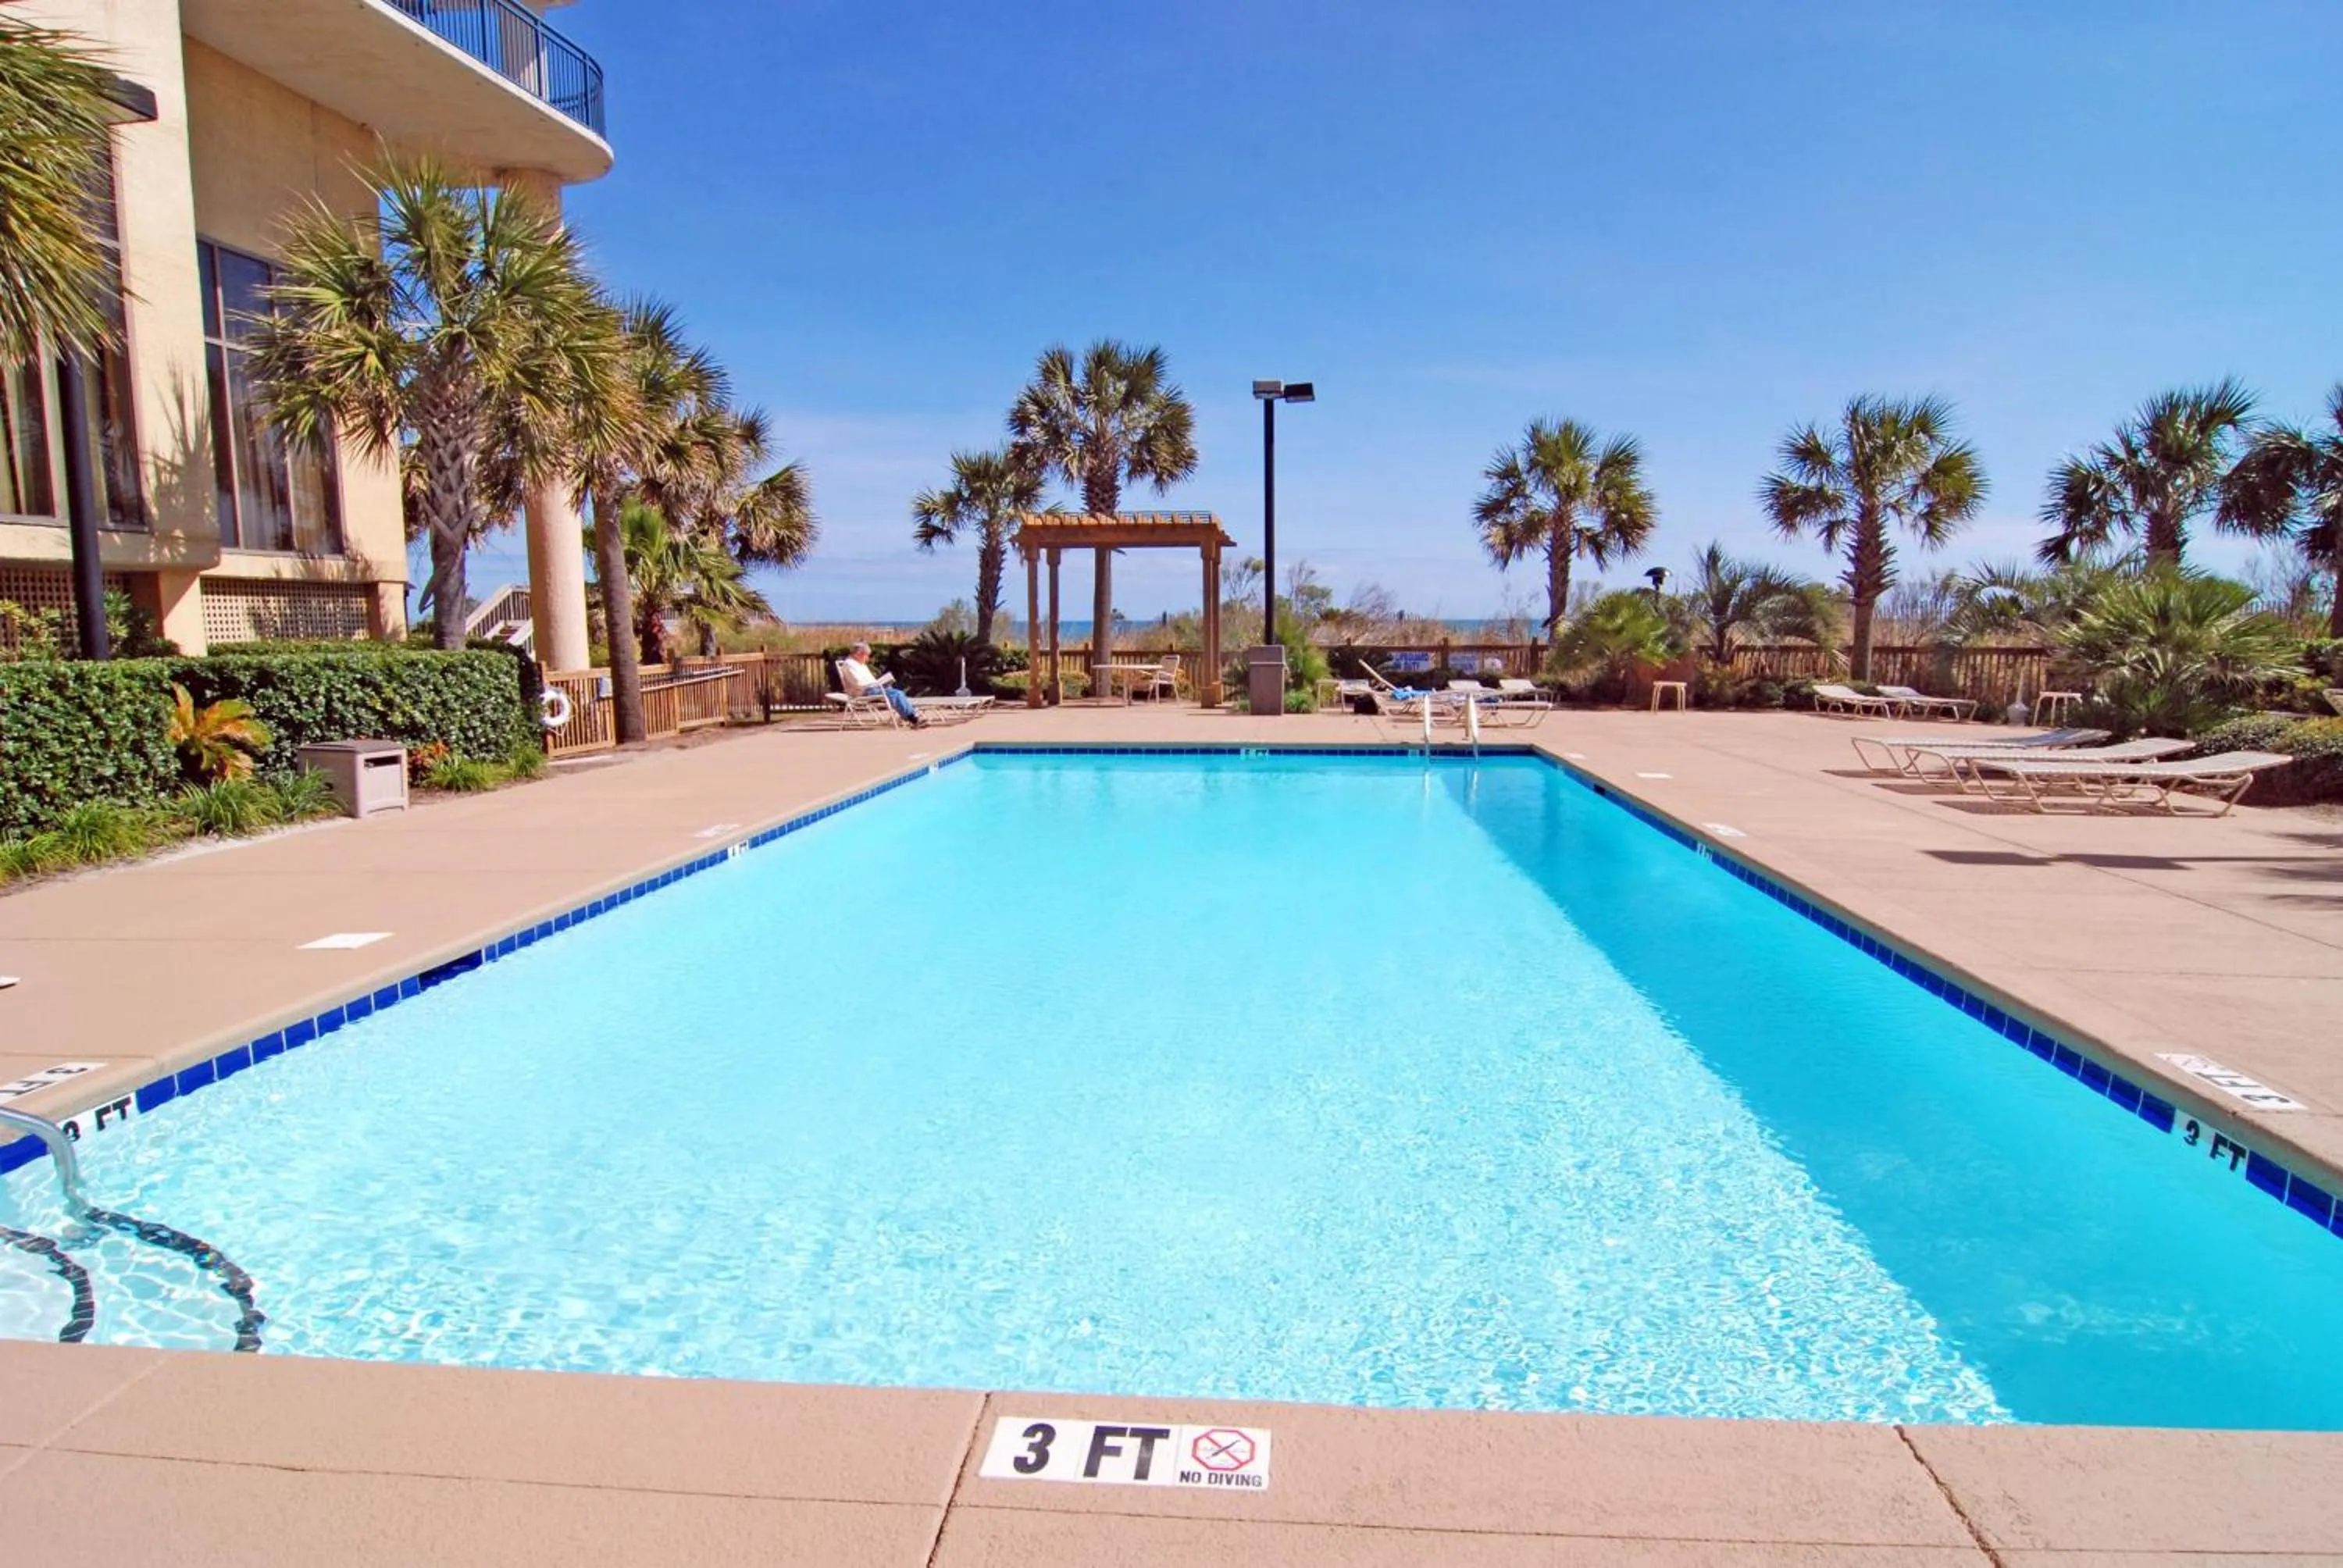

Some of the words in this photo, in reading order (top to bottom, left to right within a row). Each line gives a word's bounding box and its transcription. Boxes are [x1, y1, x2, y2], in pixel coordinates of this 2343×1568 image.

[95, 1096, 132, 1131] FT
[2184, 1120, 2200, 1146] 3
[2209, 1132, 2247, 1171] FT
[1013, 1423, 1056, 1474] 3
[1082, 1425, 1171, 1481] FT
[1179, 1471, 1202, 1484] NO
[1208, 1472, 1263, 1487] DIVING
